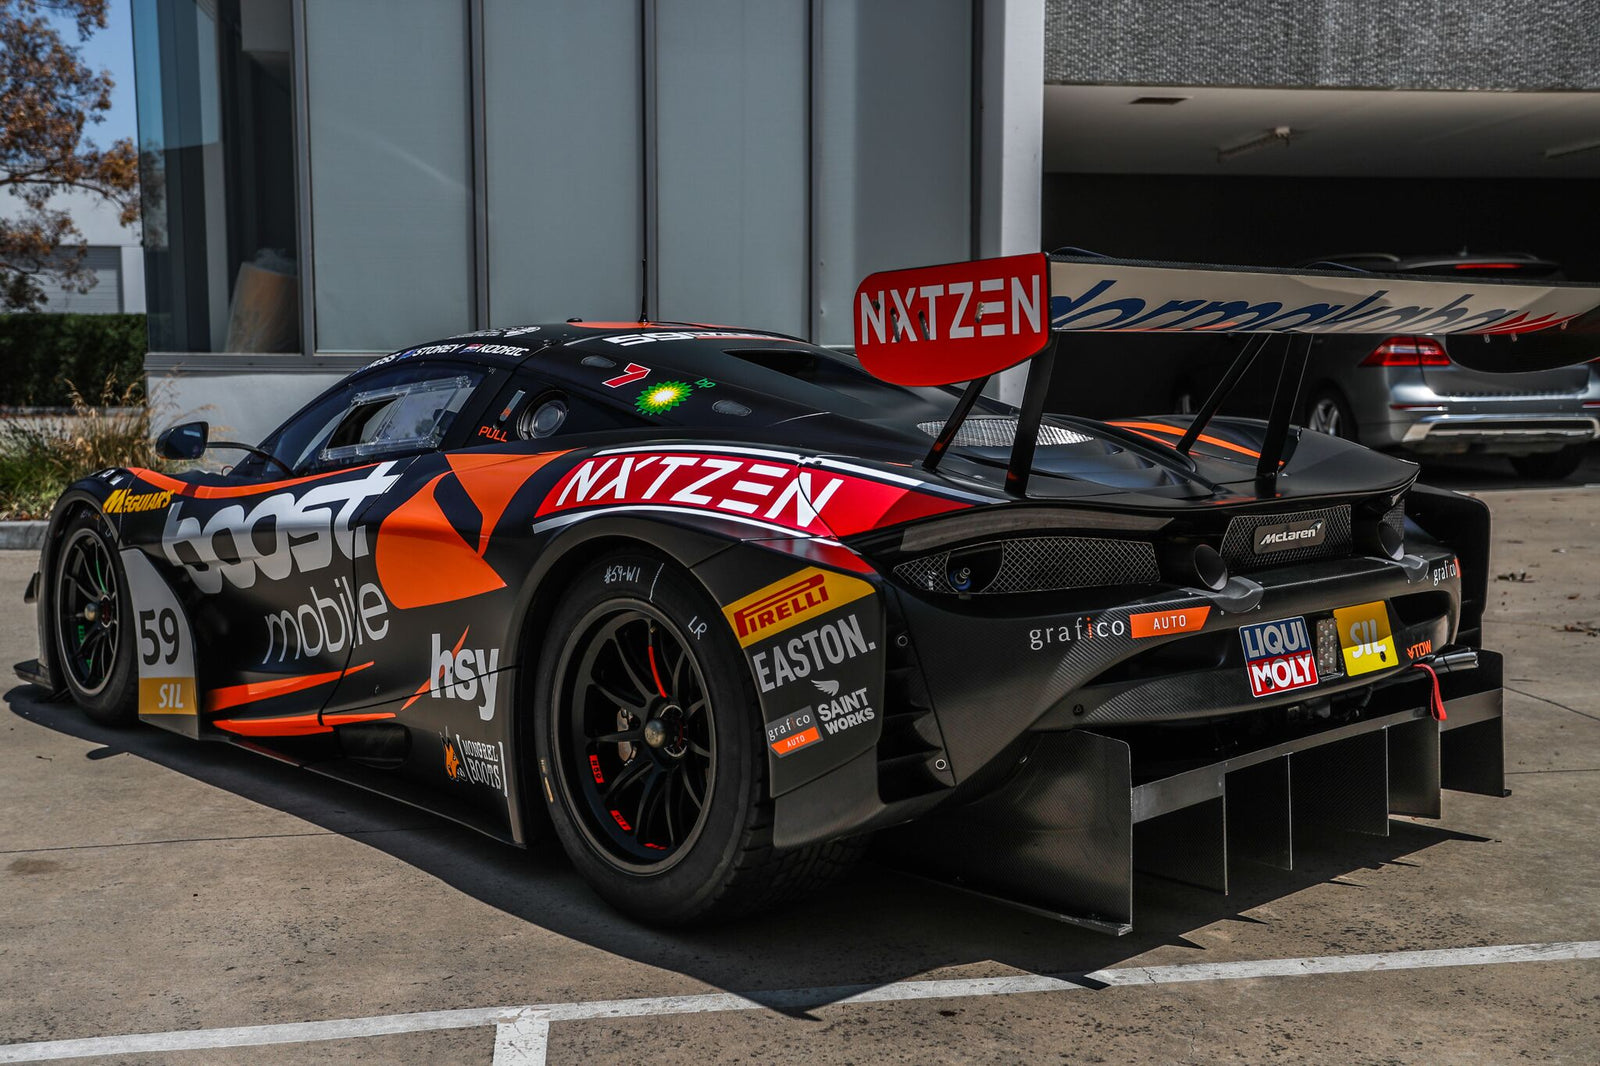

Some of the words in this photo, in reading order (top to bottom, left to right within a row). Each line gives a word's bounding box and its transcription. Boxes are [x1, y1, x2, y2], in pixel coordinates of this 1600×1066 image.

[860, 275, 1041, 345] NXTZEN
[412, 344, 465, 357] STOREY
[476, 344, 530, 356] KODRIC
[602, 331, 696, 346] 59
[695, 378, 716, 388] bp
[478, 425, 507, 442] PULL
[556, 456, 844, 527] NXTZEN
[162, 460, 404, 594] boost
[1260, 528, 1316, 544] McLaren
[1433, 560, 1456, 586] grafico
[262, 576, 389, 665] mobile
[733, 573, 829, 638] PIRELLI
[139, 608, 180, 666] 59
[688, 615, 707, 640] LR
[1029, 617, 1125, 651] grafico
[1153, 614, 1187, 630] AUTO
[1243, 621, 1307, 658] LIQUI
[1350, 618, 1387, 659] SIL
[752, 613, 876, 693] EASTON.
[1412, 639, 1432, 658] TOW
[430, 633, 500, 721] hsy
[1251, 652, 1312, 692] MOLY
[158, 683, 184, 708] SIL
[817, 687, 869, 722] SAINT
[768, 714, 811, 742] grafico
[824, 707, 875, 735] WORKS
[461, 739, 499, 762] MONGREL
[787, 734, 806, 749] AUTO
[467, 757, 501, 790] BOOTS
